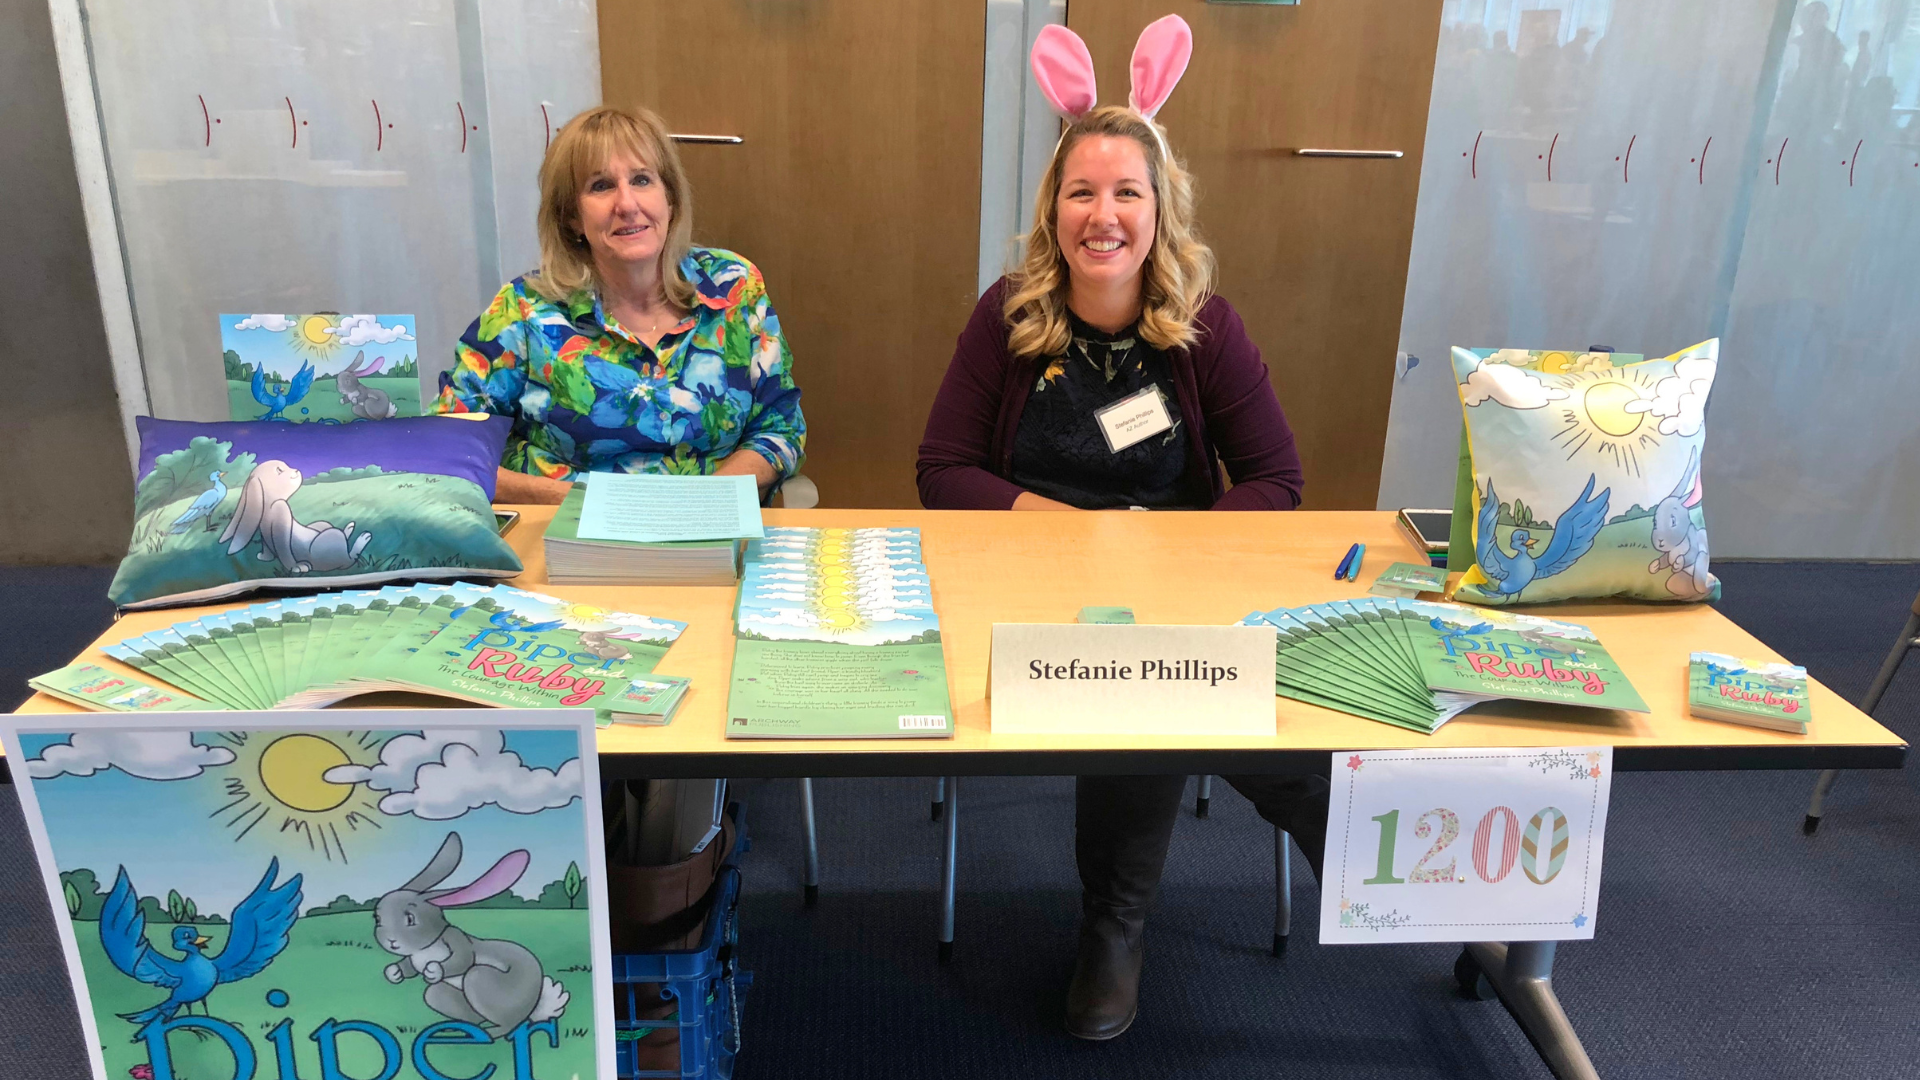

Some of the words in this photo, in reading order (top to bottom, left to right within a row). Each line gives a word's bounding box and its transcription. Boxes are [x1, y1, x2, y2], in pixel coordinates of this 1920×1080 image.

[467, 647, 606, 706] Ruby
[582, 666, 626, 679] and
[1029, 658, 1133, 680] Stefanie
[1140, 659, 1238, 687] Phillips
[1464, 651, 1610, 696] Ruby
[1563, 659, 1603, 671] and
[438, 664, 459, 675] The
[461, 670, 515, 689] Courage
[518, 683, 560, 700] Within
[451, 678, 497, 696] Stefanie
[500, 690, 542, 707] Phillips
[1453, 670, 1476, 680] The
[1479, 674, 1534, 687] Courage
[1536, 679, 1580, 690] Within
[1481, 682, 1529, 694] Stefanie
[1530, 686, 1576, 699] Phillips
[1719, 684, 1803, 713] Ruby
[750, 717, 802, 725] ARCHWAY
[1362, 805, 1570, 886] 12.00
